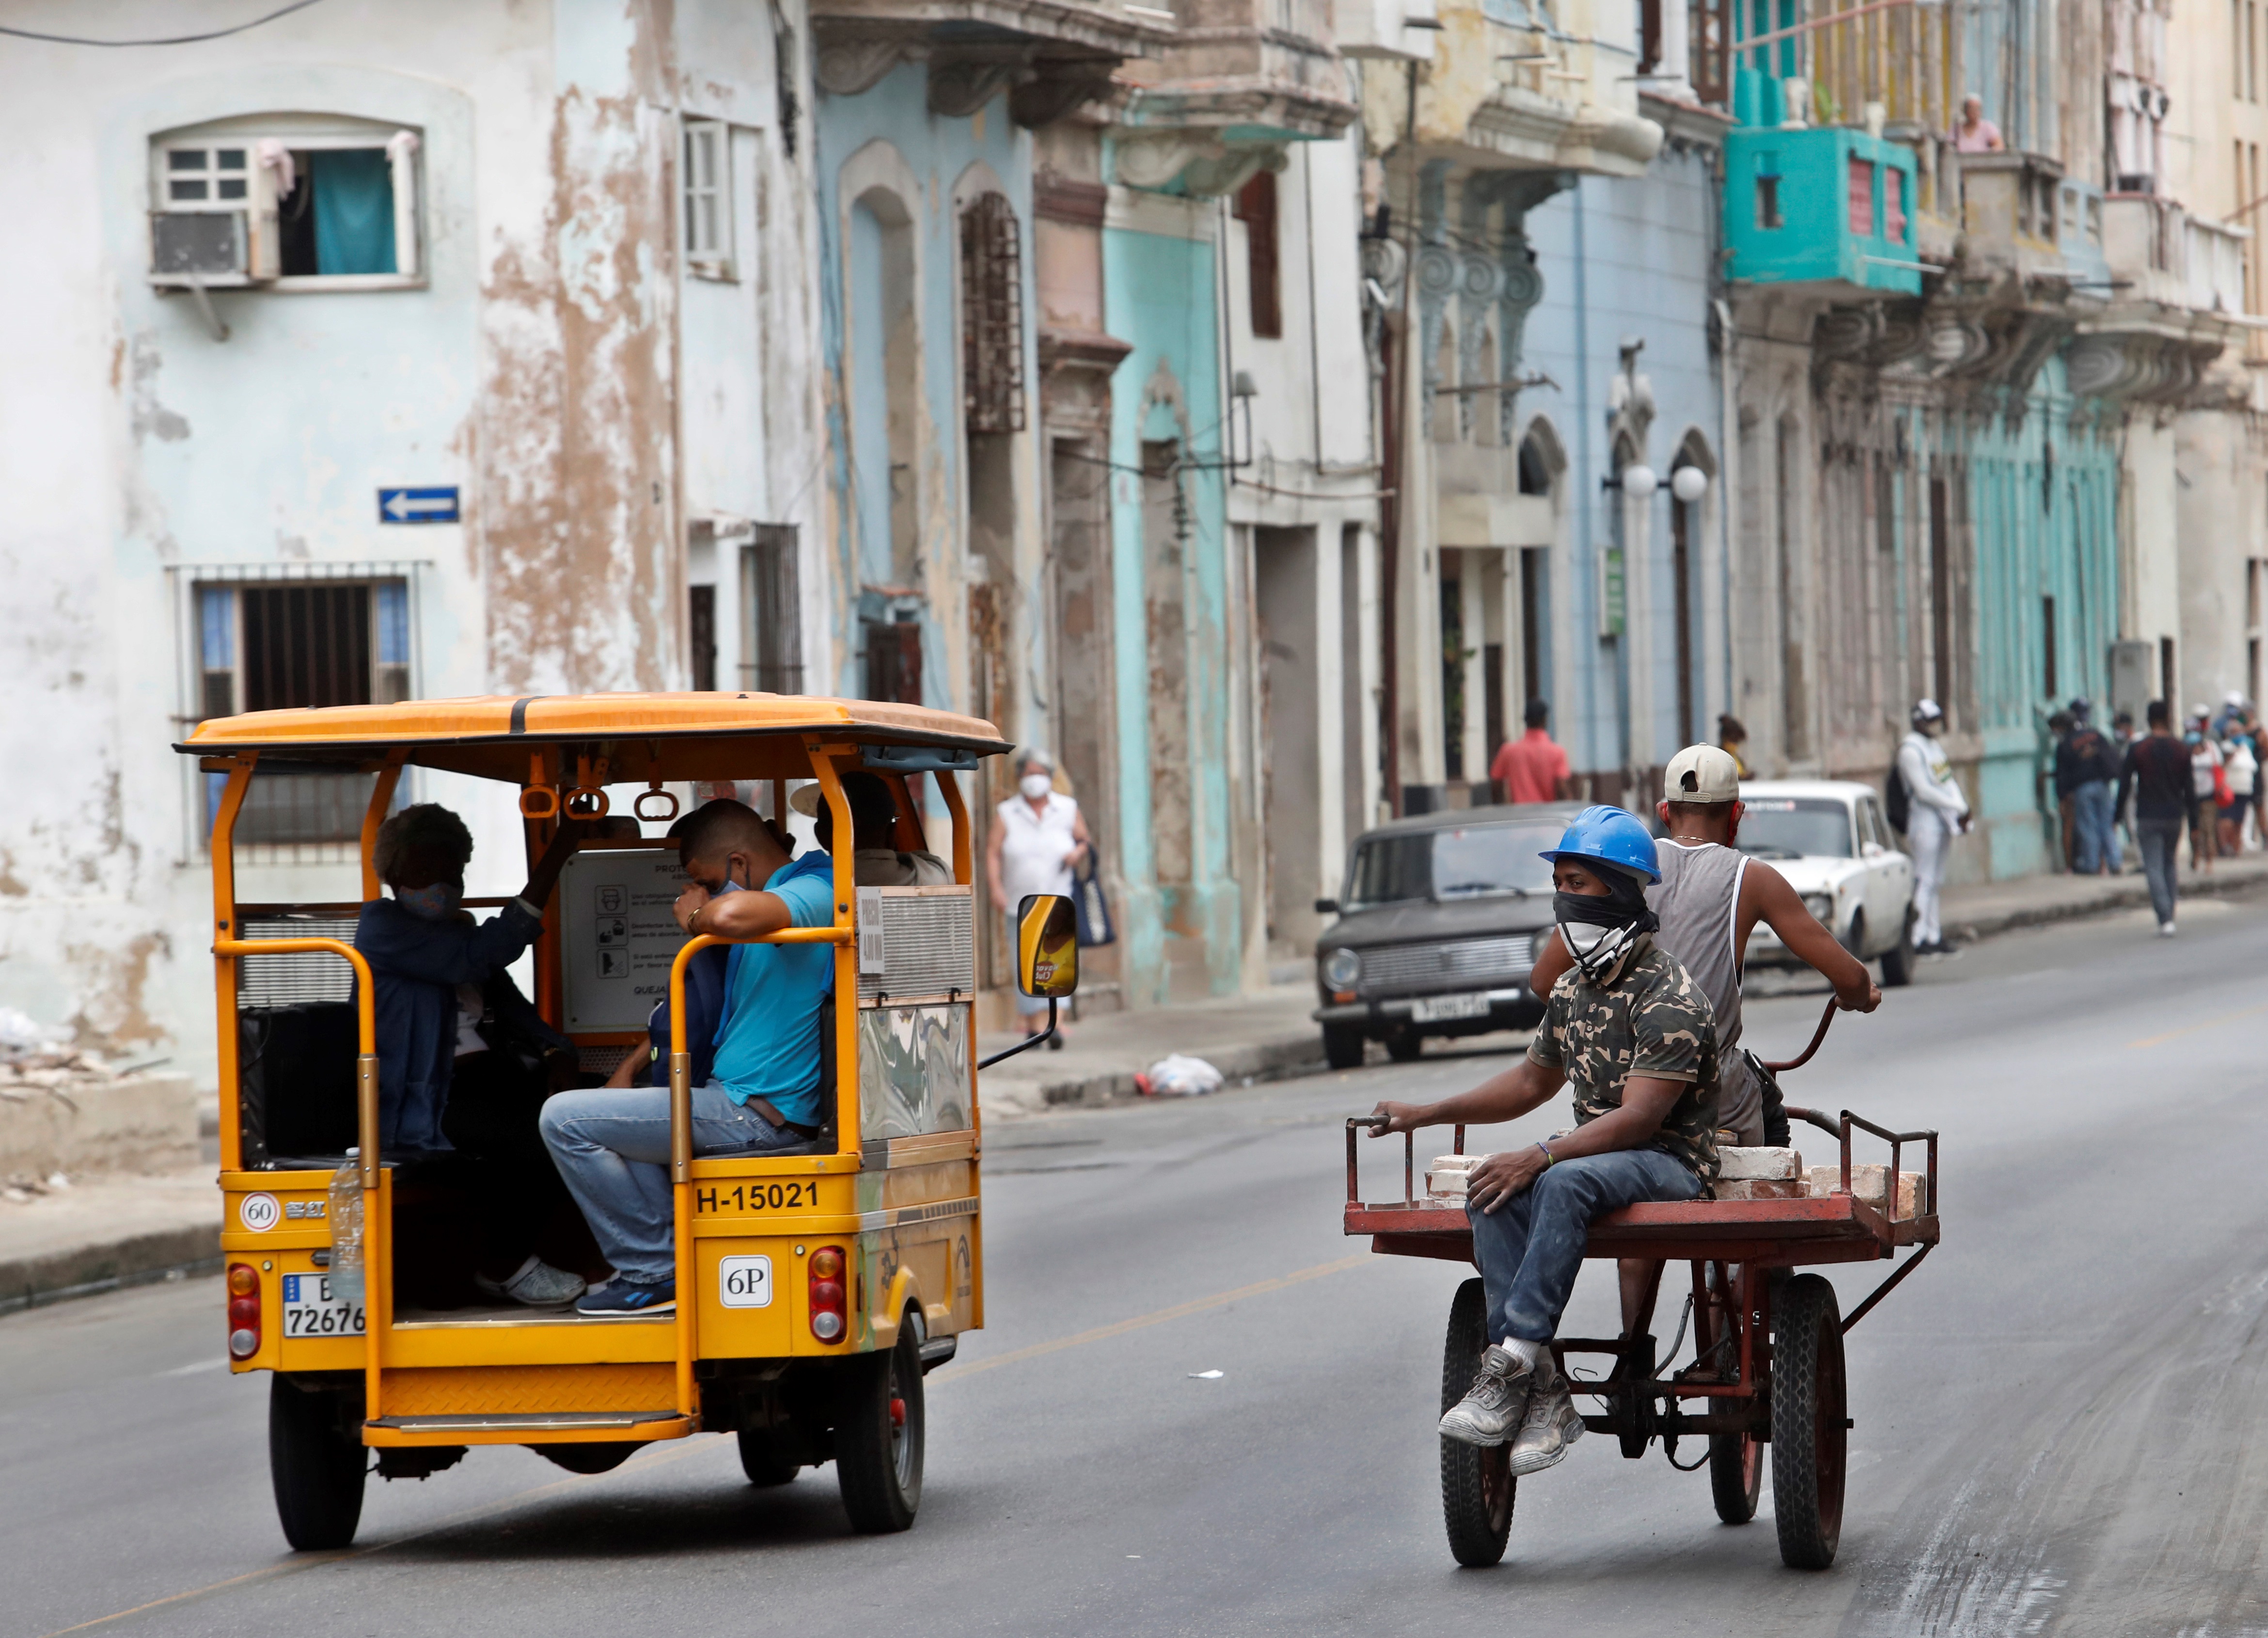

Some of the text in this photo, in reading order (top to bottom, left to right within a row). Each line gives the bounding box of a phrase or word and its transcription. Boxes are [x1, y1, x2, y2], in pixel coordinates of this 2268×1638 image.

[696, 1181, 818, 1213] H-15021
[248, 1203, 271, 1220] 60
[727, 1268, 764, 1294] 6P
[289, 1307, 365, 1333] 72676
